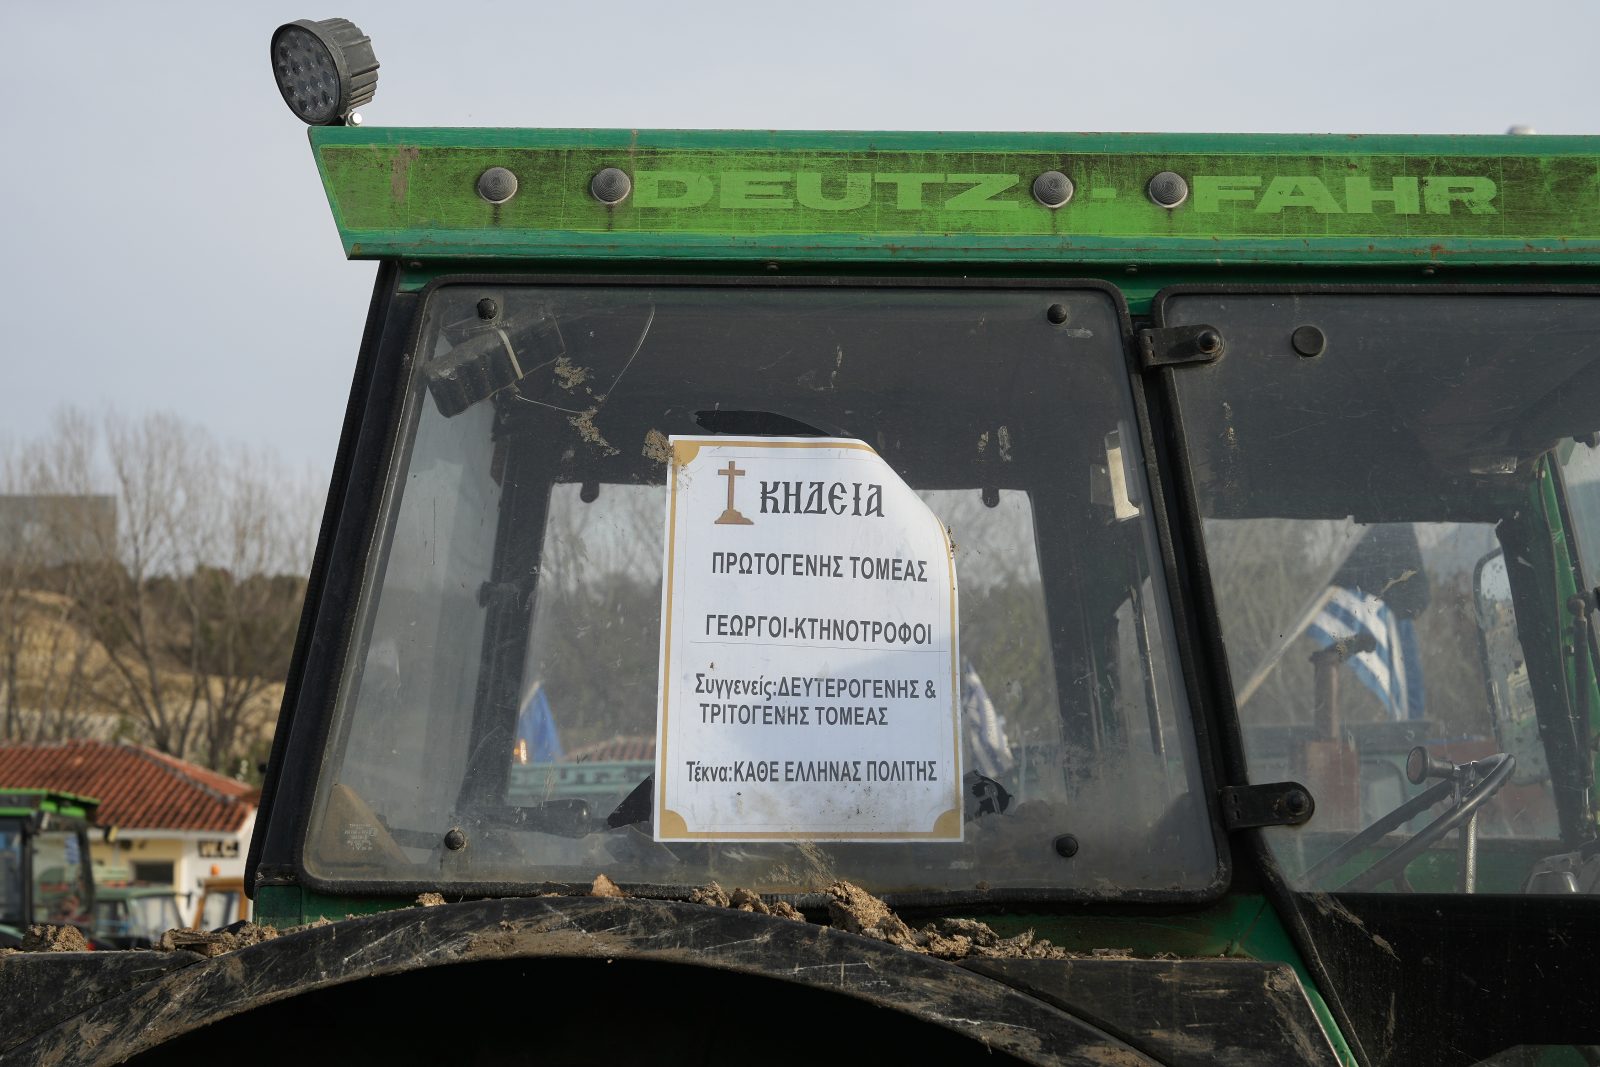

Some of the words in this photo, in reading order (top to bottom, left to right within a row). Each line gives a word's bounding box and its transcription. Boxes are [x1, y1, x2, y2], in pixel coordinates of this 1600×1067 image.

[759, 480, 884, 517] ΚΗΔΕΙΑ
[712, 552, 843, 578] ΠΡΩΤΟΓΕΝΗΣ
[849, 556, 928, 583] ΤΟΜΕΑΣ
[705, 615, 932, 645] ΓΕΩΡΓΟΙ-ΚΤΗΝΟΤΡΟΦΟΙ
[924, 679, 937, 698] &
[700, 703, 810, 726] ΤΡΙΤΟΓΕΝΗΣ
[814, 707, 889, 726] ΤΟΜΕΑΣ
[784, 761, 862, 783] ΕΛΛΗΝΑΣ
[866, 760, 938, 783] ΠΟΛΙΤΗΣ
